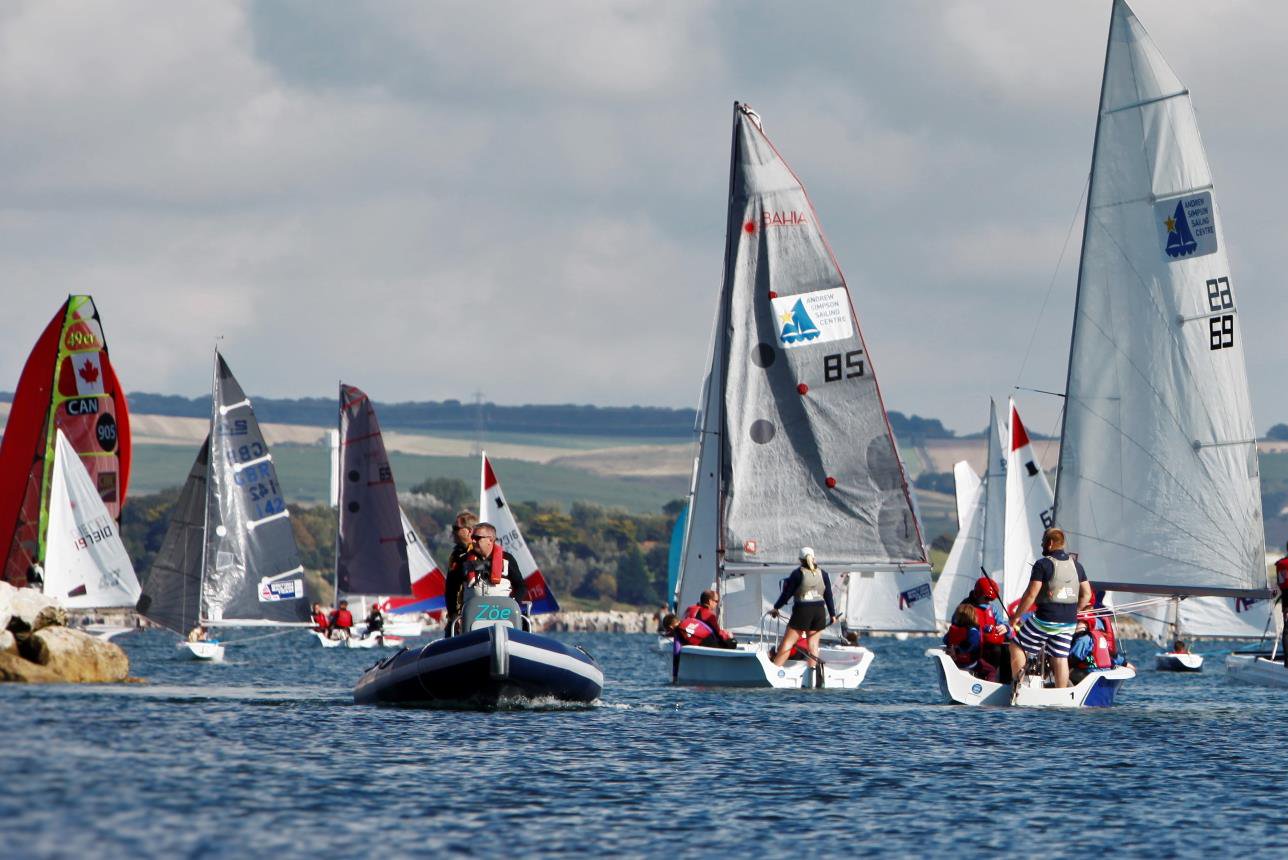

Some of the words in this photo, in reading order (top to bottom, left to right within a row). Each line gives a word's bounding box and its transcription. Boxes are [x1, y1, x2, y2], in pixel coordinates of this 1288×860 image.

[763, 210, 808, 226] BAHIA
[1195, 225, 1215, 237] CENTRE
[806, 294, 835, 304] ANDREW
[811, 301, 840, 311] SIMPSON
[815, 308, 841, 319] SAILING
[819, 316, 847, 326] CENTRE
[1209, 314, 1234, 350] 69
[824, 349, 865, 383] 85
[68, 399, 98, 415] CAN
[74, 525, 112, 552] 197310
[474, 603, 512, 621] Zöe
